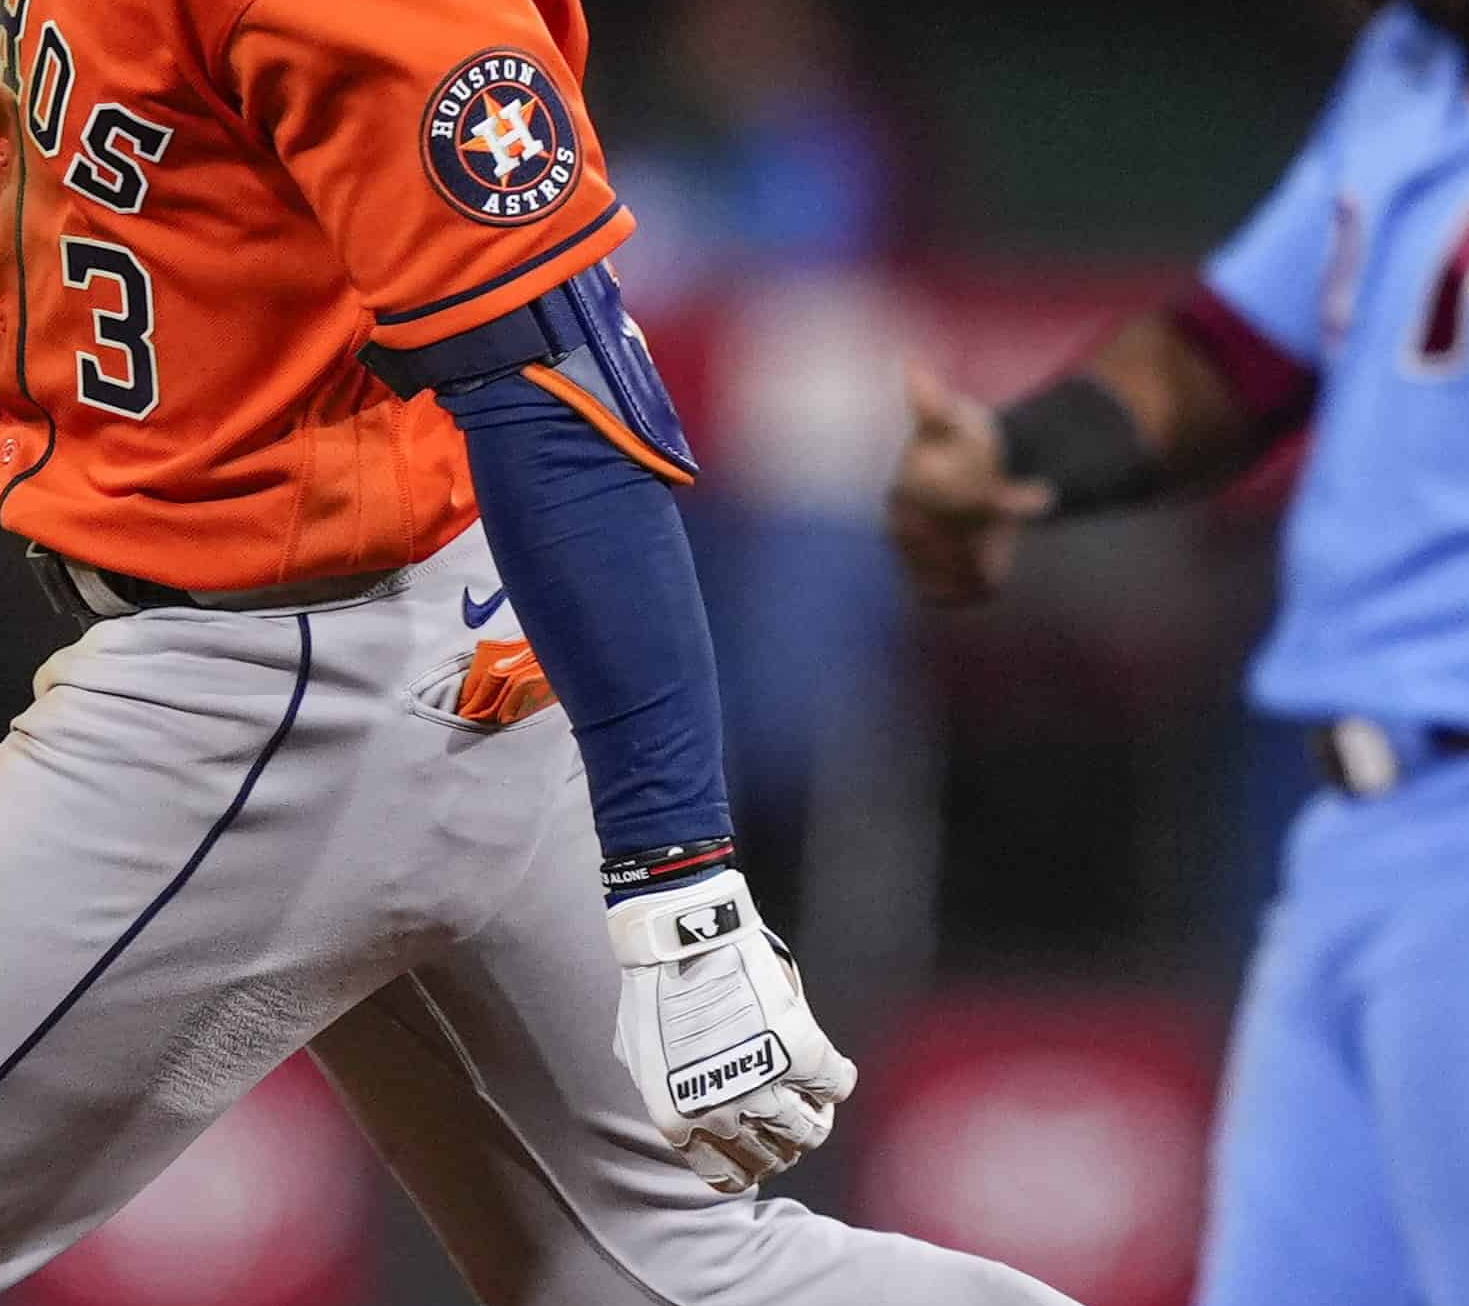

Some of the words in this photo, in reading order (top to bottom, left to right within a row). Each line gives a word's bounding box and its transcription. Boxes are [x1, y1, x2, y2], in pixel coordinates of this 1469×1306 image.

[431, 59, 536, 139] HOUSTON
[481, 147, 575, 216] ASTROS
[59, 234, 161, 422] 3
[610, 867, 650, 885] ALONE
